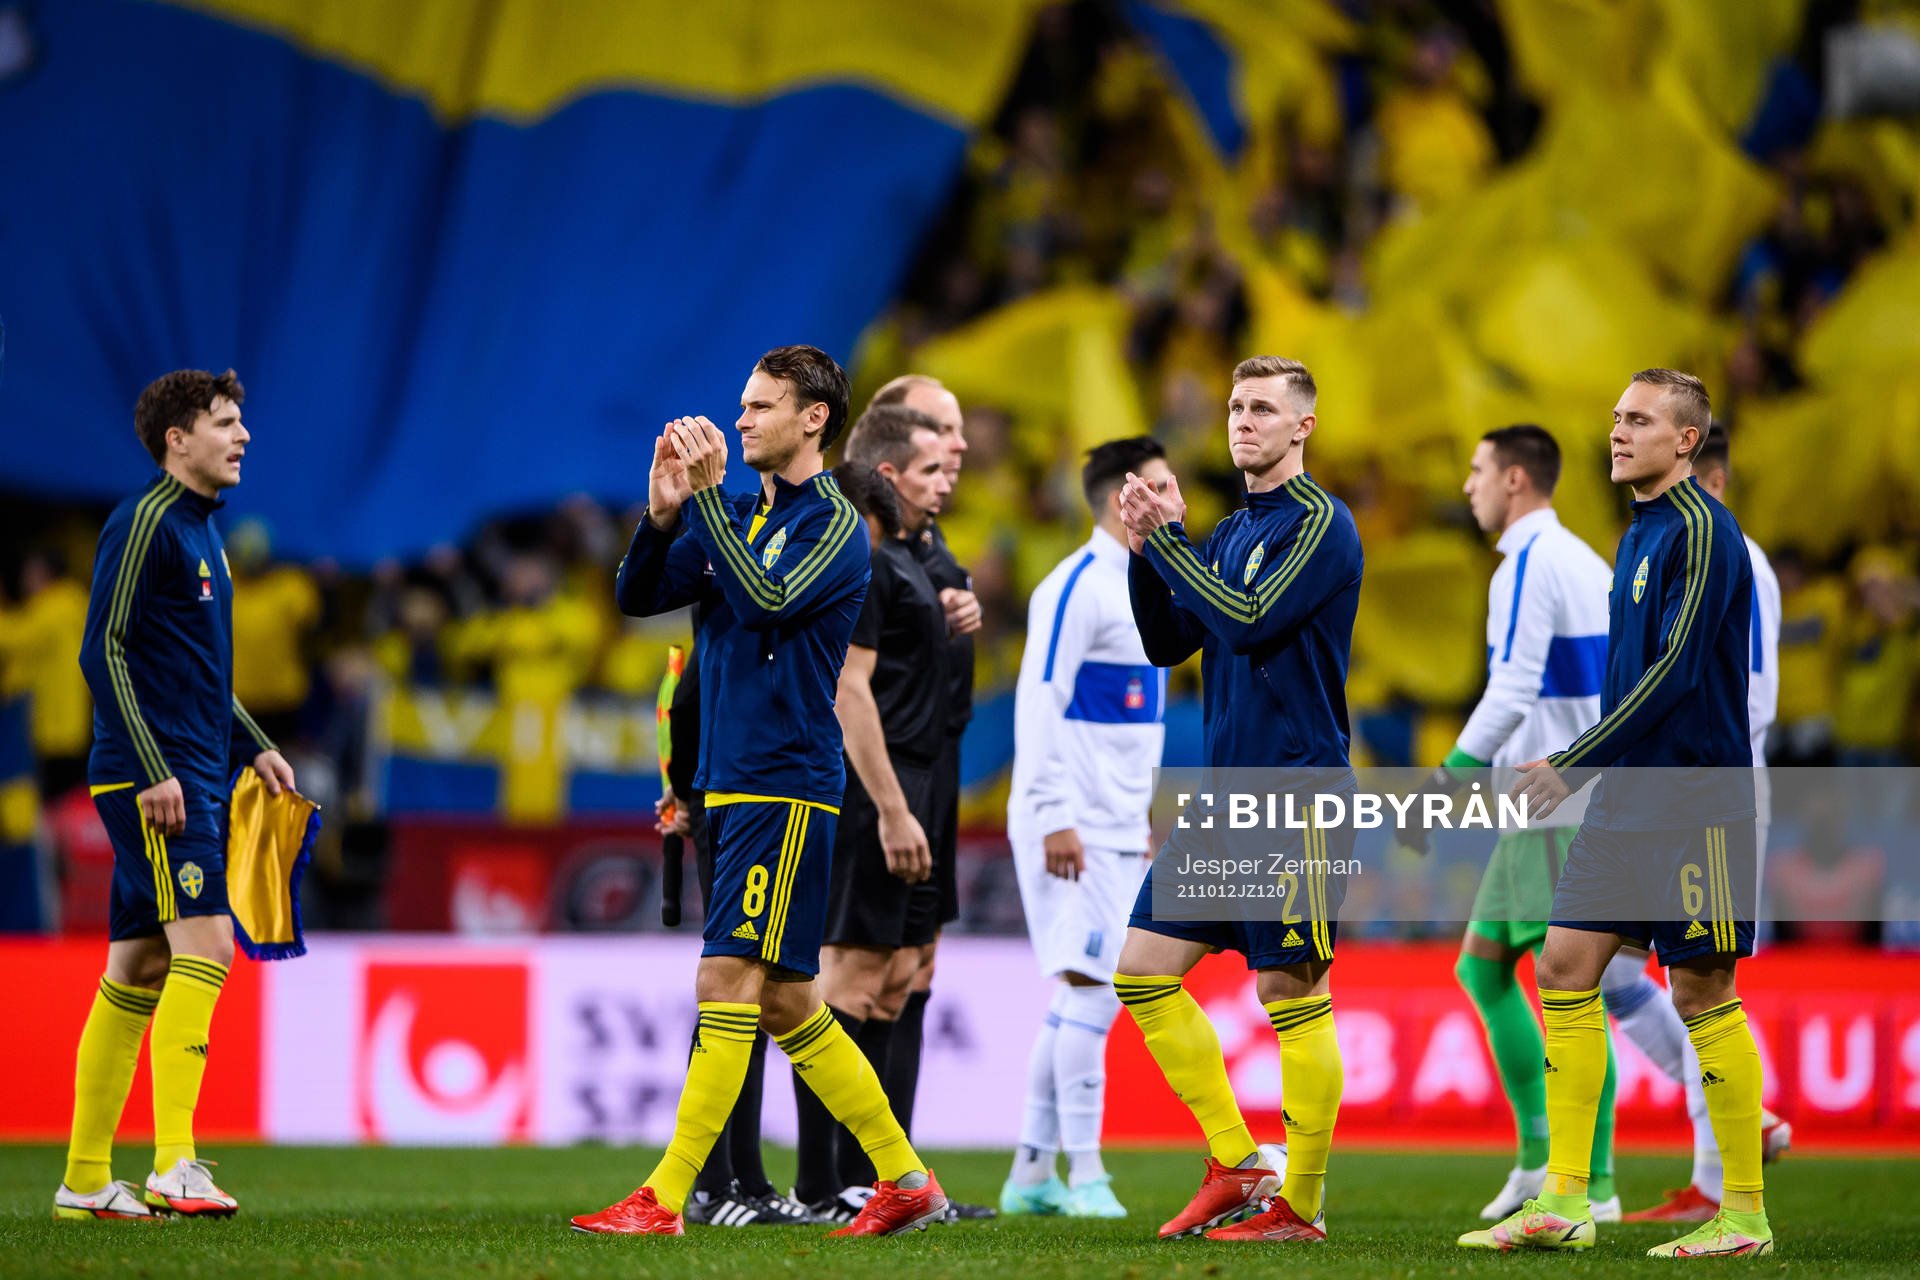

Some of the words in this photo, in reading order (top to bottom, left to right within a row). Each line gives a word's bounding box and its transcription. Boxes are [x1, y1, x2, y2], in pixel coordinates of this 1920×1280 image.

[743, 864, 769, 917] 8
[1278, 871, 1302, 925] 2
[1680, 863, 1703, 916] 6
[732, 930, 759, 941] adidas
[1281, 938, 1304, 948] adidas
[1684, 928, 1709, 940] adidas
